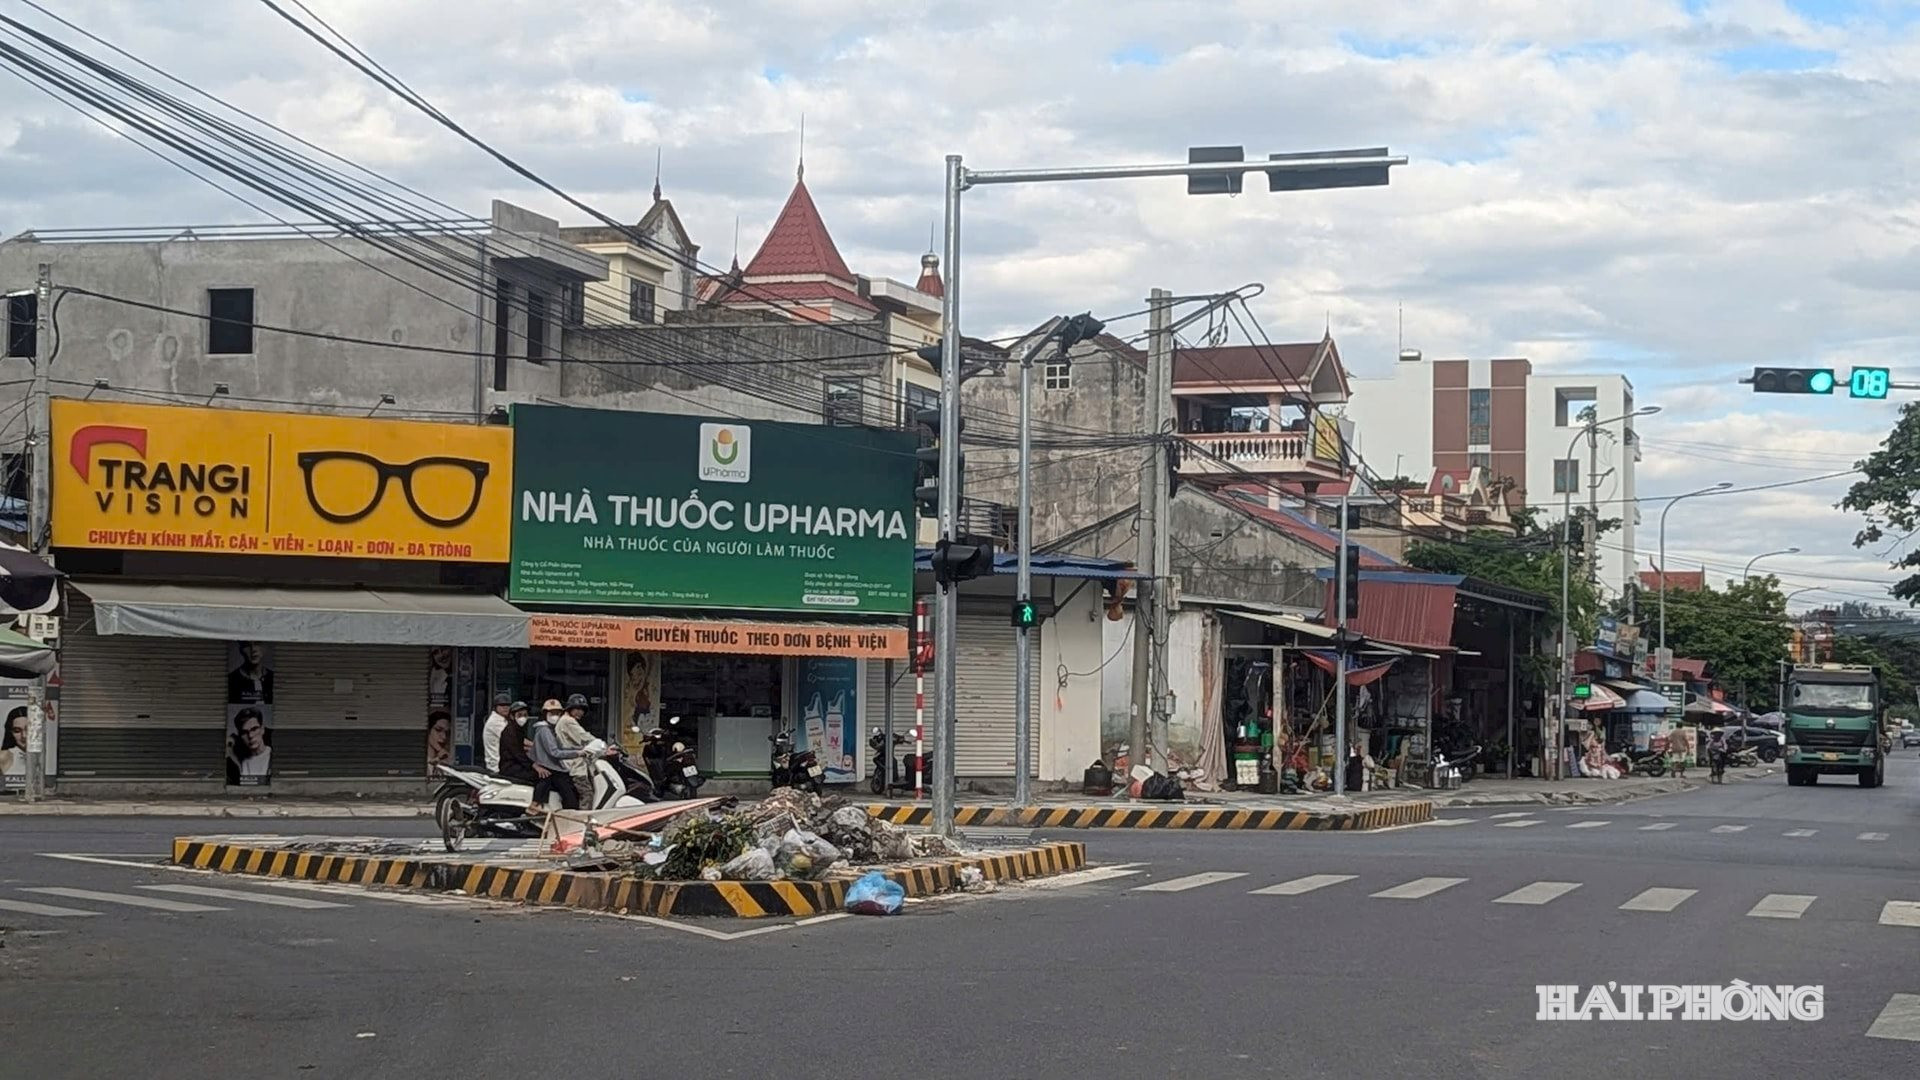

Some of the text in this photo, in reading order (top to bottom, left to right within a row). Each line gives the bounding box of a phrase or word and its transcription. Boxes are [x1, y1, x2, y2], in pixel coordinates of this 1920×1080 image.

[1852, 369, 1887, 397] 08
[98, 458, 250, 495] TRANGI
[95, 491, 249, 519] VISION
[522, 488, 907, 540] NHÀ THUỐC UPHARMA
[88, 529, 147, 546] CHUYÊN
[151, 530, 186, 547] KÍNH
[229, 533, 258, 551] CẬN
[317, 539, 353, 555] LOẠN
[367, 541, 395, 555] ĐƠN
[408, 543, 426, 556] ĐA
[429, 541, 472, 557] TRÒNG
[583, 535, 836, 560] NHÀ THUỐC CỦA NGƯỜI LÀM THUỐC
[532, 618, 550, 627] NHÀ
[581, 621, 621, 631] UPHARMA
[634, 626, 888, 651] CHUYÊN THUỐC THEO ĐƠN BỆNH VIỆN
